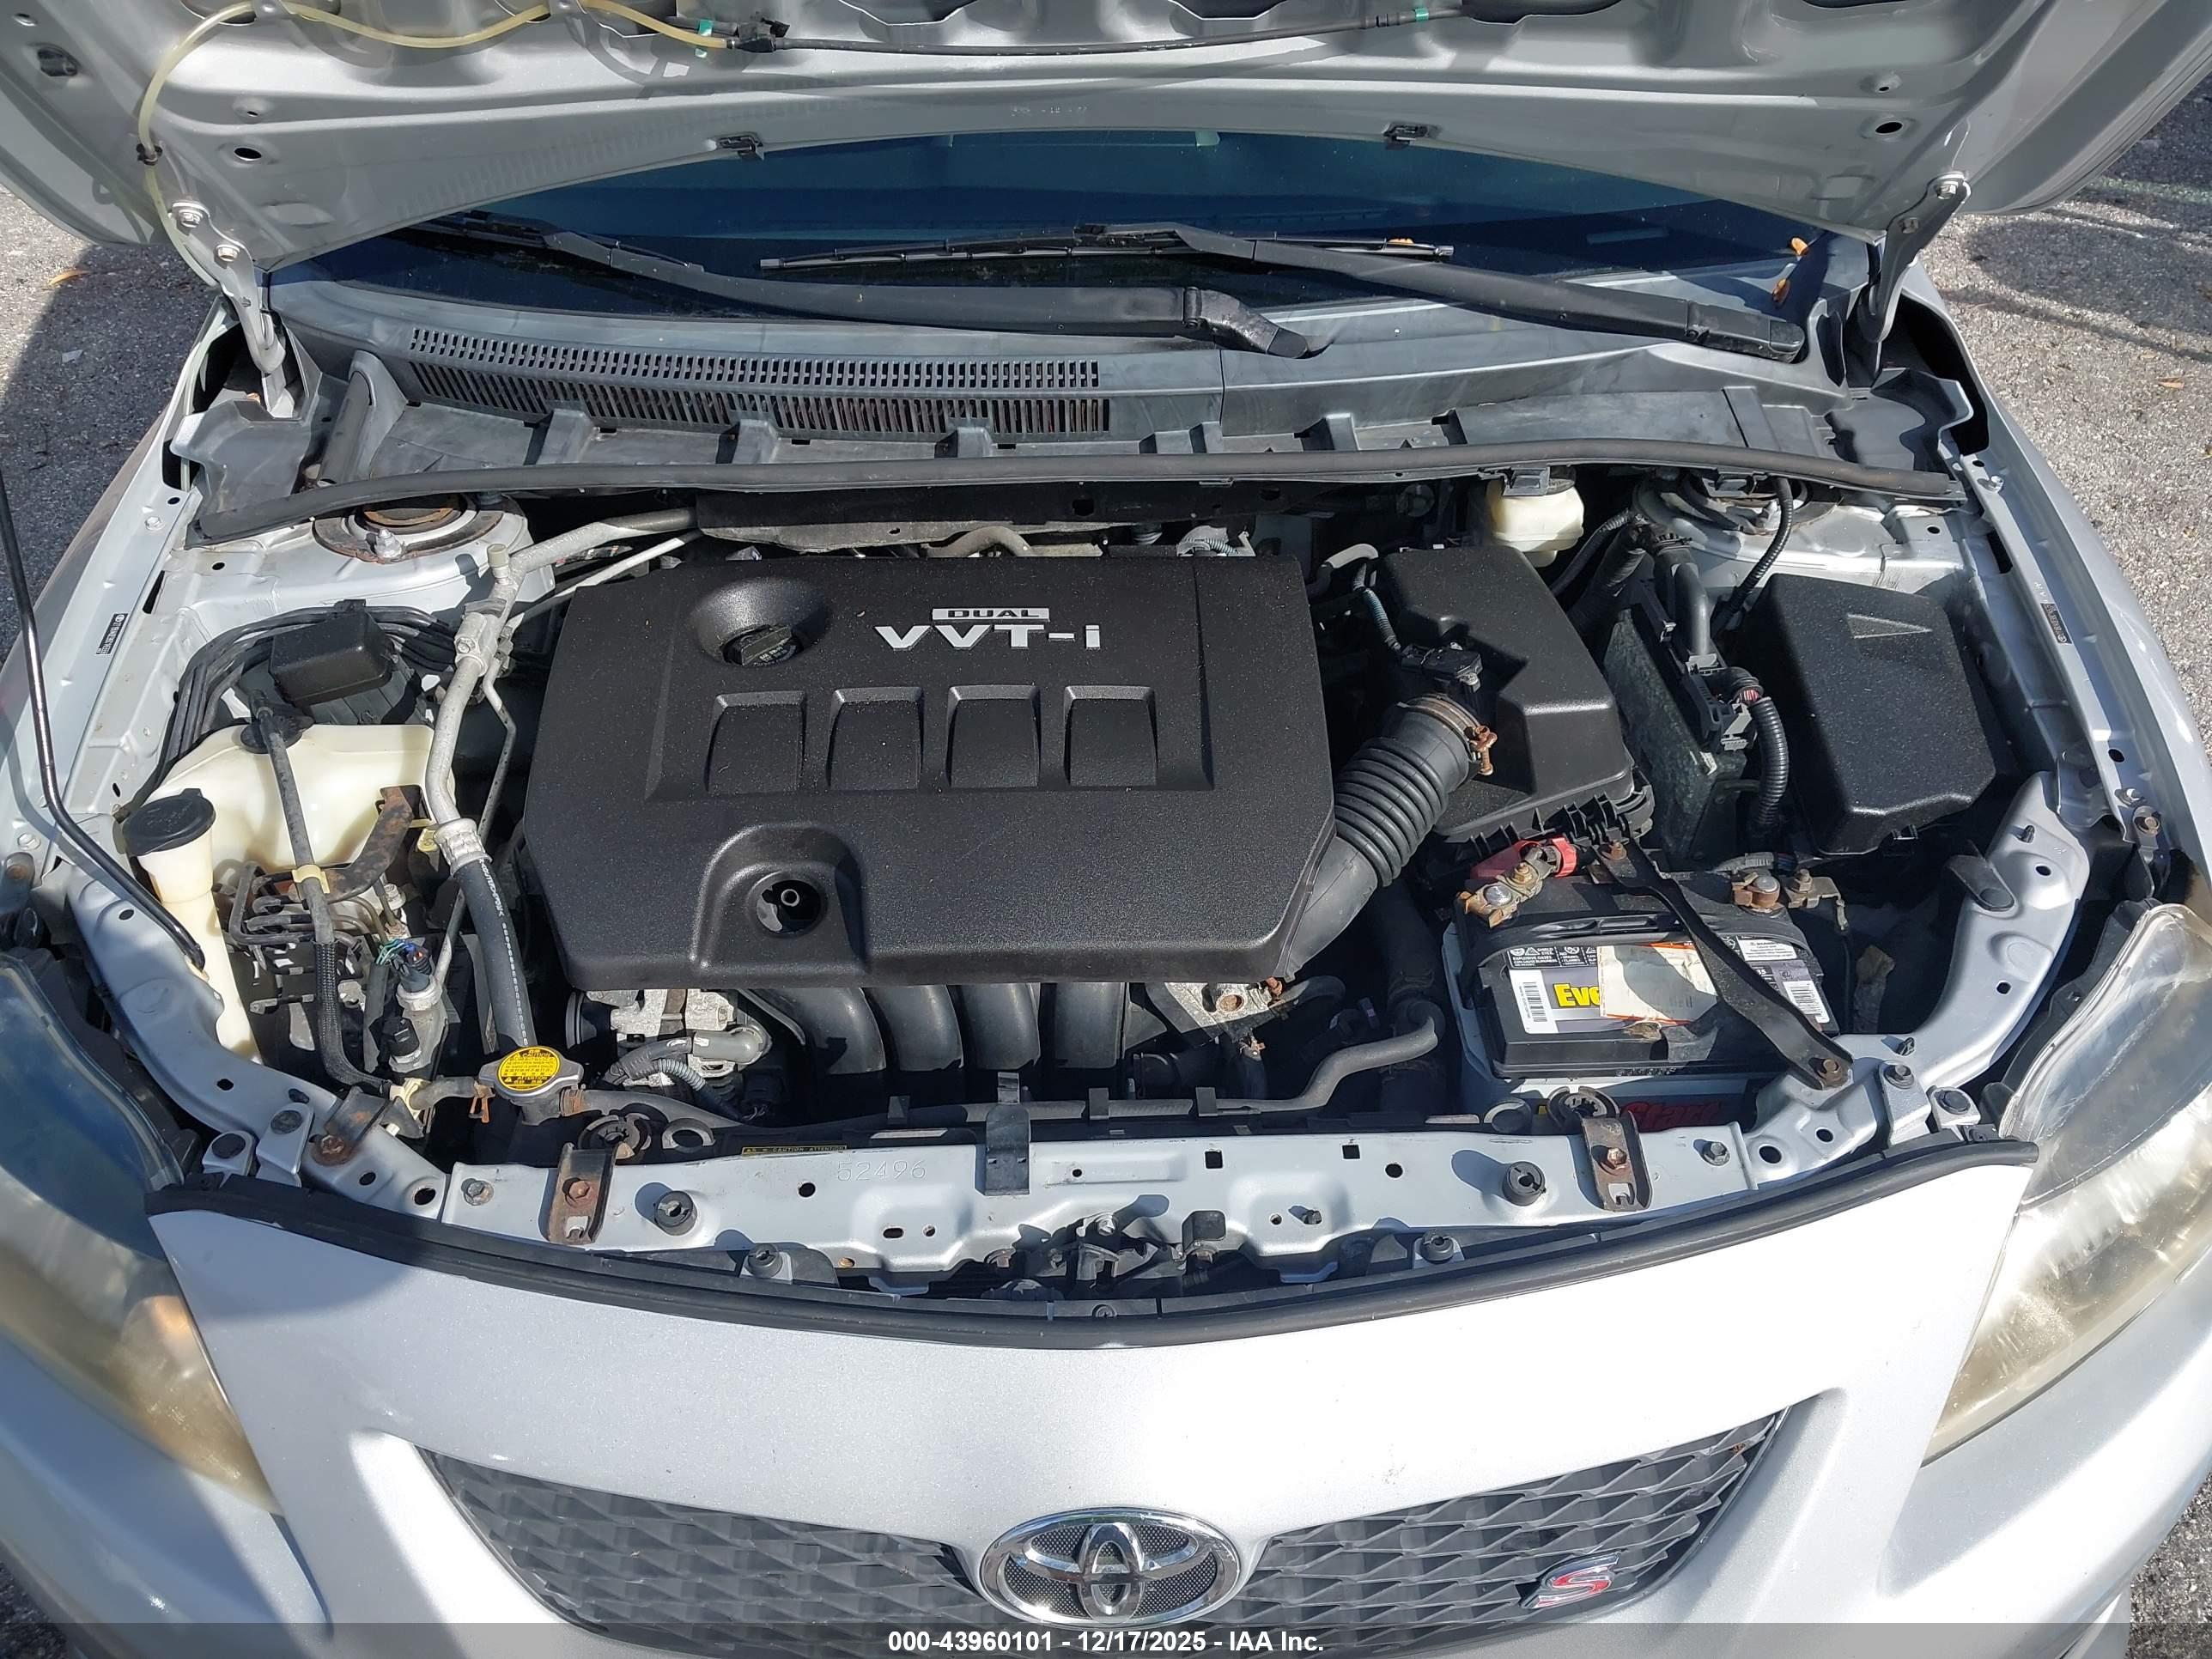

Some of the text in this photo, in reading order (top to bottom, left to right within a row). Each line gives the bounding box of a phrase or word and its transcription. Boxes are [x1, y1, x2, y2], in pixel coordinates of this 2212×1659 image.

[947, 609, 1041, 618] DUAL
[874, 624, 1101, 648] VVT-i
[837, 1160, 927, 1182] 52496
